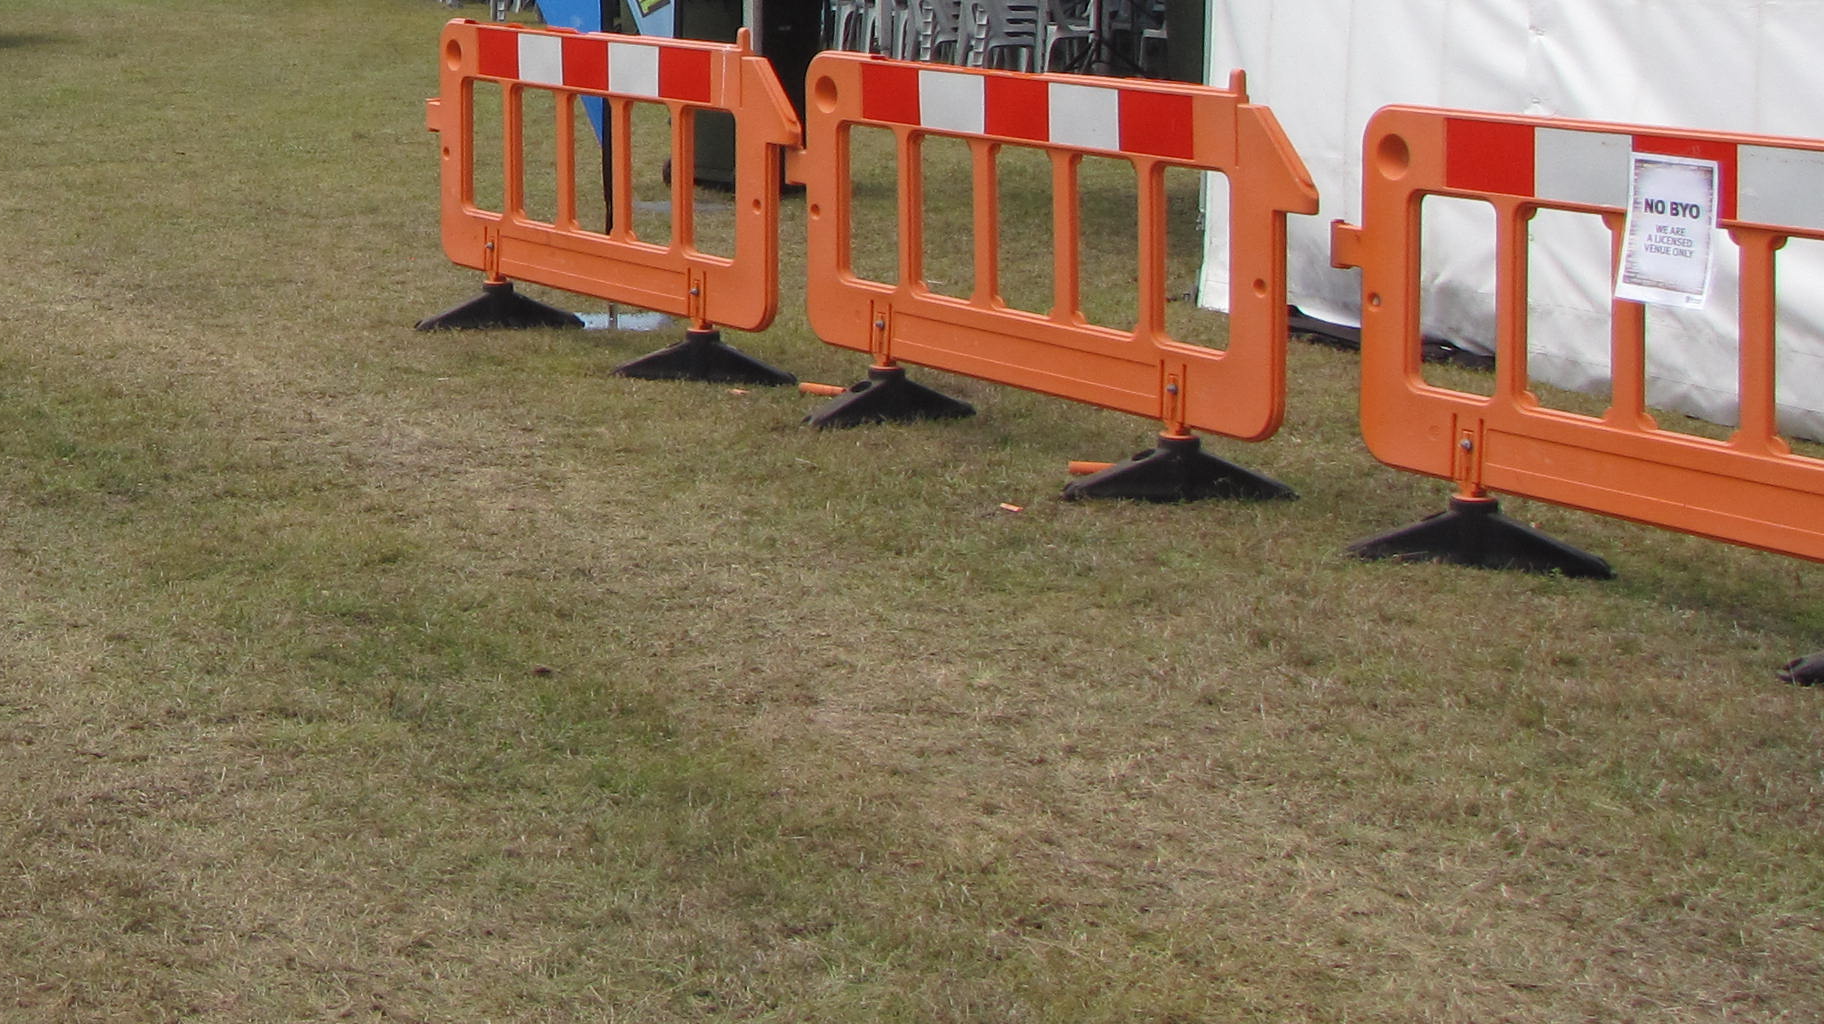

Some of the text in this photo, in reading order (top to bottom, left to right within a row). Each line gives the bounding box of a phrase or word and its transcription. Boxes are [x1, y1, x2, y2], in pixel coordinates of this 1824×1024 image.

[1644, 198, 1701, 220] NO BYO
[1655, 226, 1686, 236] WE ARE
[1647, 234, 1693, 248] A LICENSED
[1644, 243, 1695, 258] VENUE ONLY
